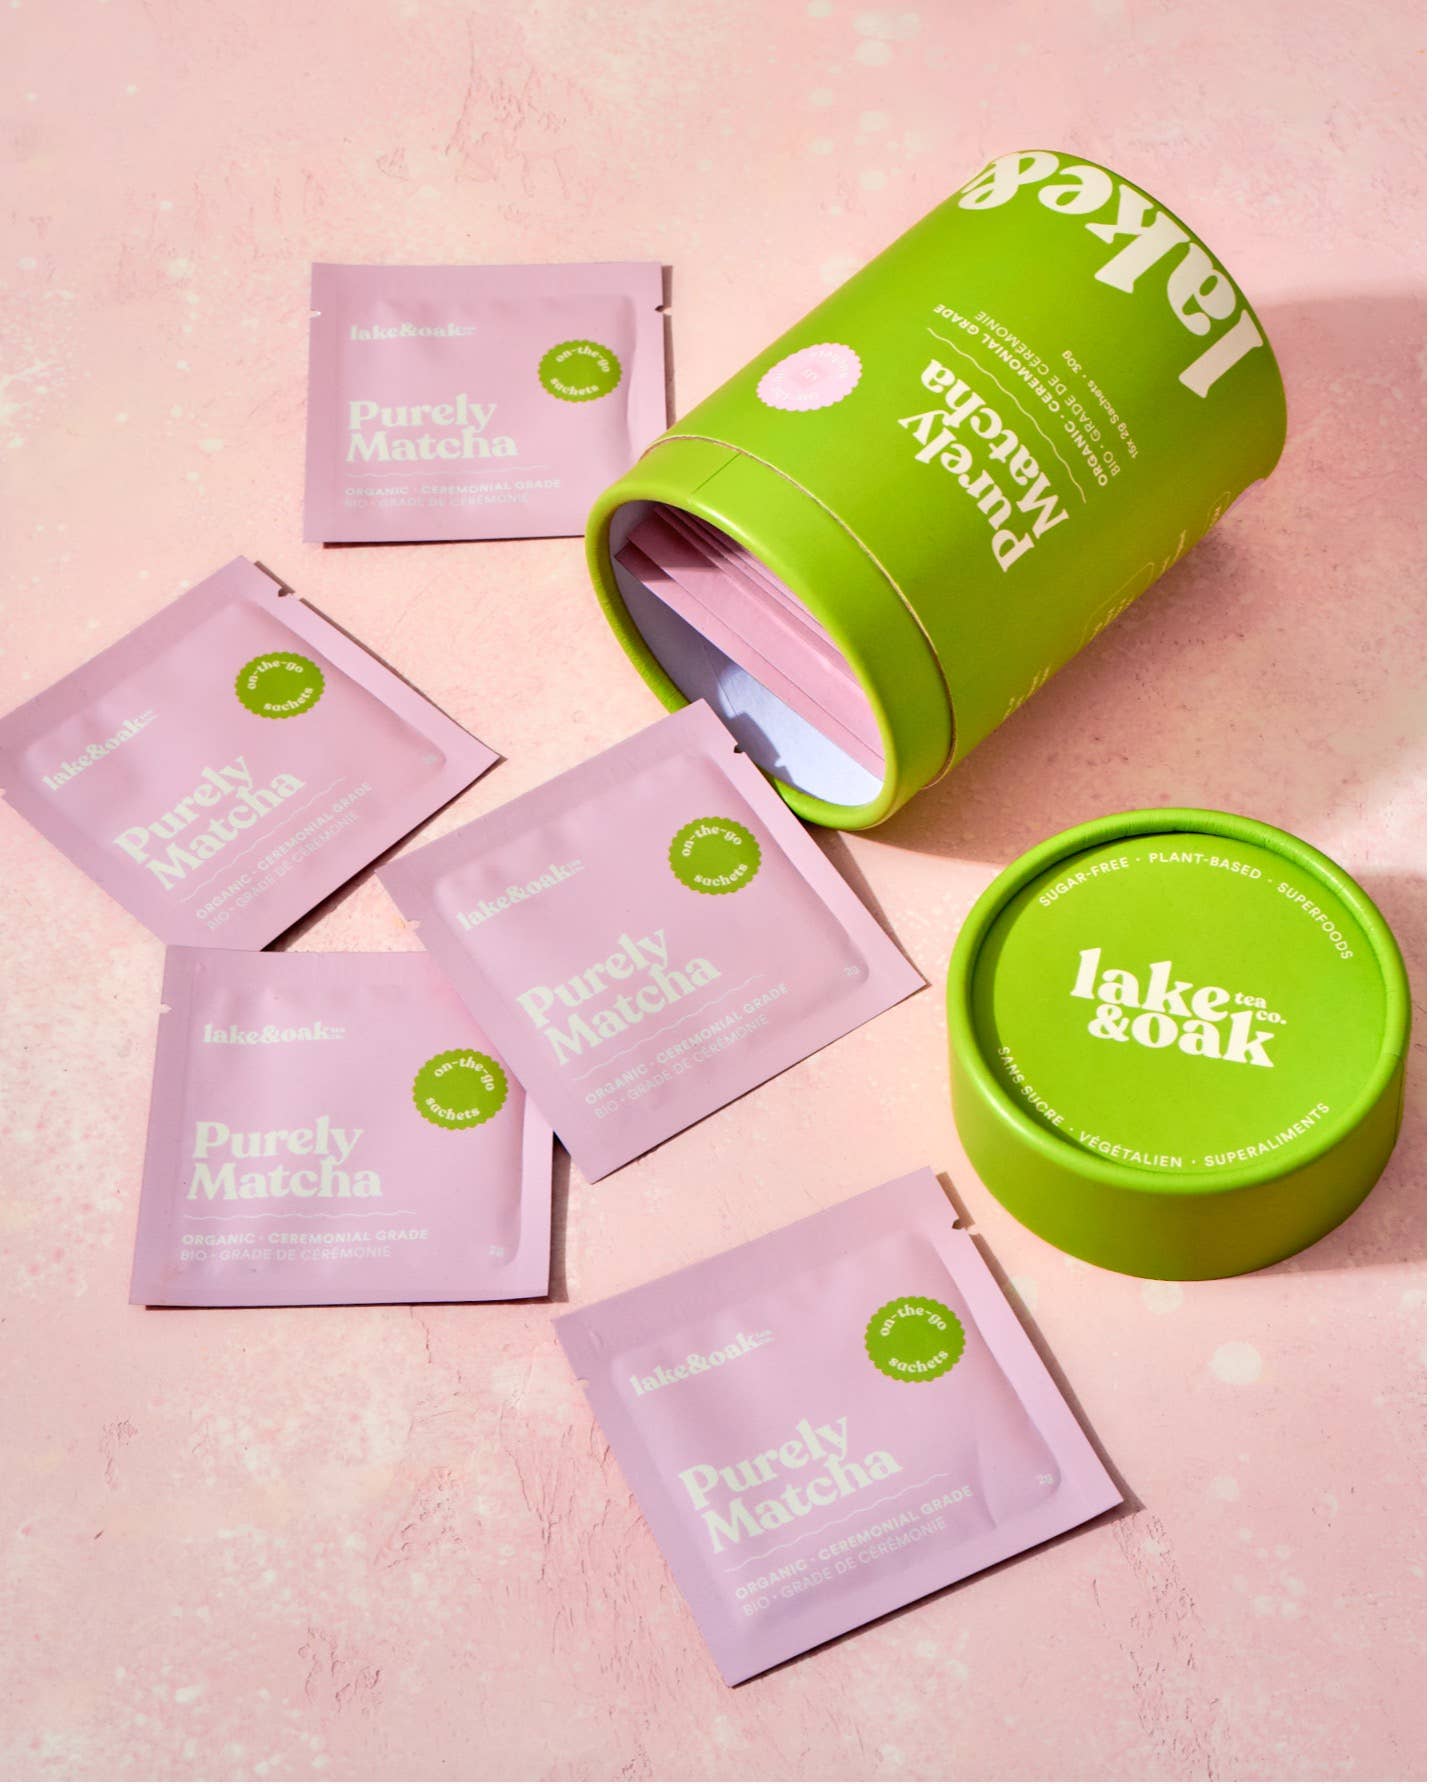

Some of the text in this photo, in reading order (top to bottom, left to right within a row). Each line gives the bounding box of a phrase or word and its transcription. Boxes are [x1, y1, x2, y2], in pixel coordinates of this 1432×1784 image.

[555, 345, 610, 373] on-the-go
[1062, 350, 1082, 374] 30g
[550, 377, 600, 396] sachets
[933, 303, 1108, 486] ORGANIC CEREMONIAL GRADE
[973, 311, 1121, 476] BIO GRADE DE CÉRÉMONIE
[1087, 379, 1120, 425] Sachets
[348, 393, 497, 433] Purely
[1116, 422, 1130, 440] 2g
[345, 425, 520, 463] Matcha
[919, 358, 1070, 540] Matcha
[514, 479, 561, 490] GRADE
[897, 408, 1034, 573] Purely
[246, 659, 304, 690] on-the-go
[263, 686, 314, 712] sachets
[113, 756, 255, 865] Purely
[145, 773, 306, 891] Matcha
[195, 782, 373, 920] ORGANIC CEREMONIAL GRADE
[681, 824, 743, 857] on-the-go
[694, 862, 749, 887] sachets
[1038, 852, 1354, 960] SUGAR-FREE PLANT-BASED SUPERFOODS
[516, 928, 670, 1029] Purely
[1070, 947, 1267, 1023] lake tea
[543, 957, 722, 1066] Matcha
[1256, 1008, 1287, 1025] co.
[585, 983, 789, 1105] ORGANIC CEREMONIAL GRADE
[1087, 1004, 1275, 1068] &oak
[432, 1055, 496, 1092] on-the-go
[594, 1100, 619, 1119] BIO
[628, 1072, 673, 1100] GRADE
[672, 1059, 693, 1075] DE
[425, 1097, 480, 1121] sachets
[998, 1046, 1330, 1168] SANS SUCRE VÉGÉTALIEN SUPERALIMENTS
[191, 1115, 365, 1165] Purely
[186, 1155, 383, 1200] Matcha
[181, 1229, 429, 1245] ORGANIC CEREMONIAL GRADE
[220, 1248, 273, 1262] GRADE
[275, 1248, 297, 1261] DE
[880, 1304, 947, 1338] on-the-go
[888, 1349, 949, 1374] sachets
[678, 1416, 848, 1511] Purely
[701, 1448, 903, 1554] Matcha
[735, 1485, 973, 1600] ORGANIC CEREMONIAL GRADE
[742, 1595, 770, 1617] BIO
[780, 1570, 833, 1599] GRADE
[835, 1557, 857, 1574] DE
